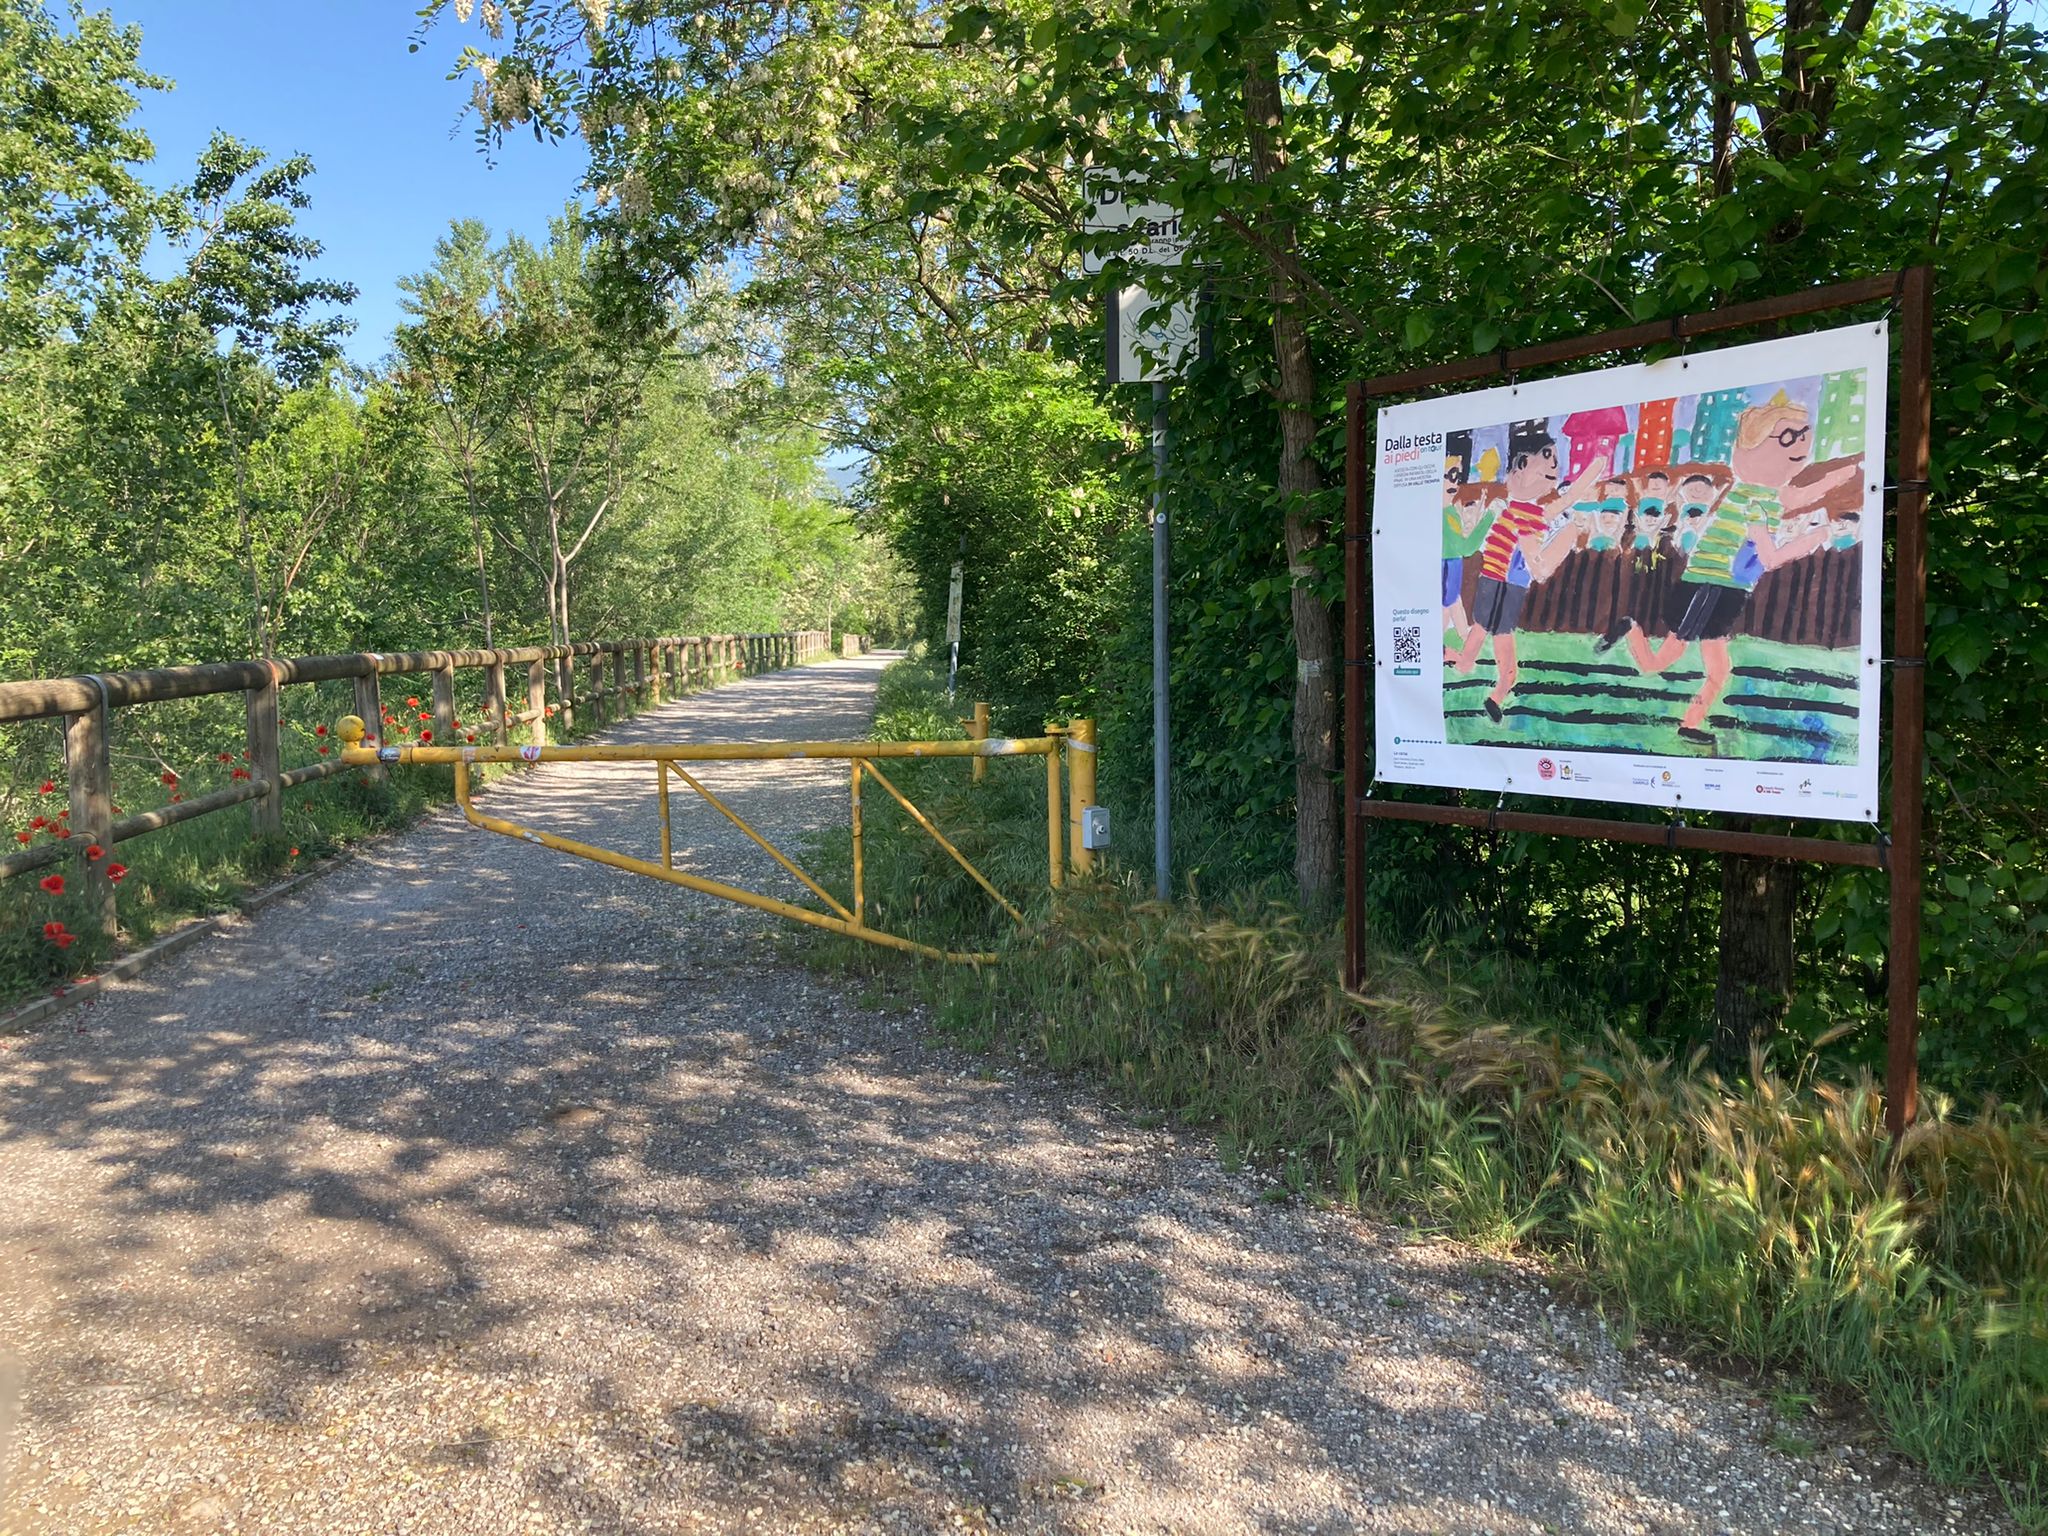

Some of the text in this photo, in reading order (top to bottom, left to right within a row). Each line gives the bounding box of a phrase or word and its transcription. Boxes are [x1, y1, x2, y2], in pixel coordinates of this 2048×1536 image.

[1385, 432, 1442, 451] Dalla testa
[1384, 446, 1420, 465] ai piedi
